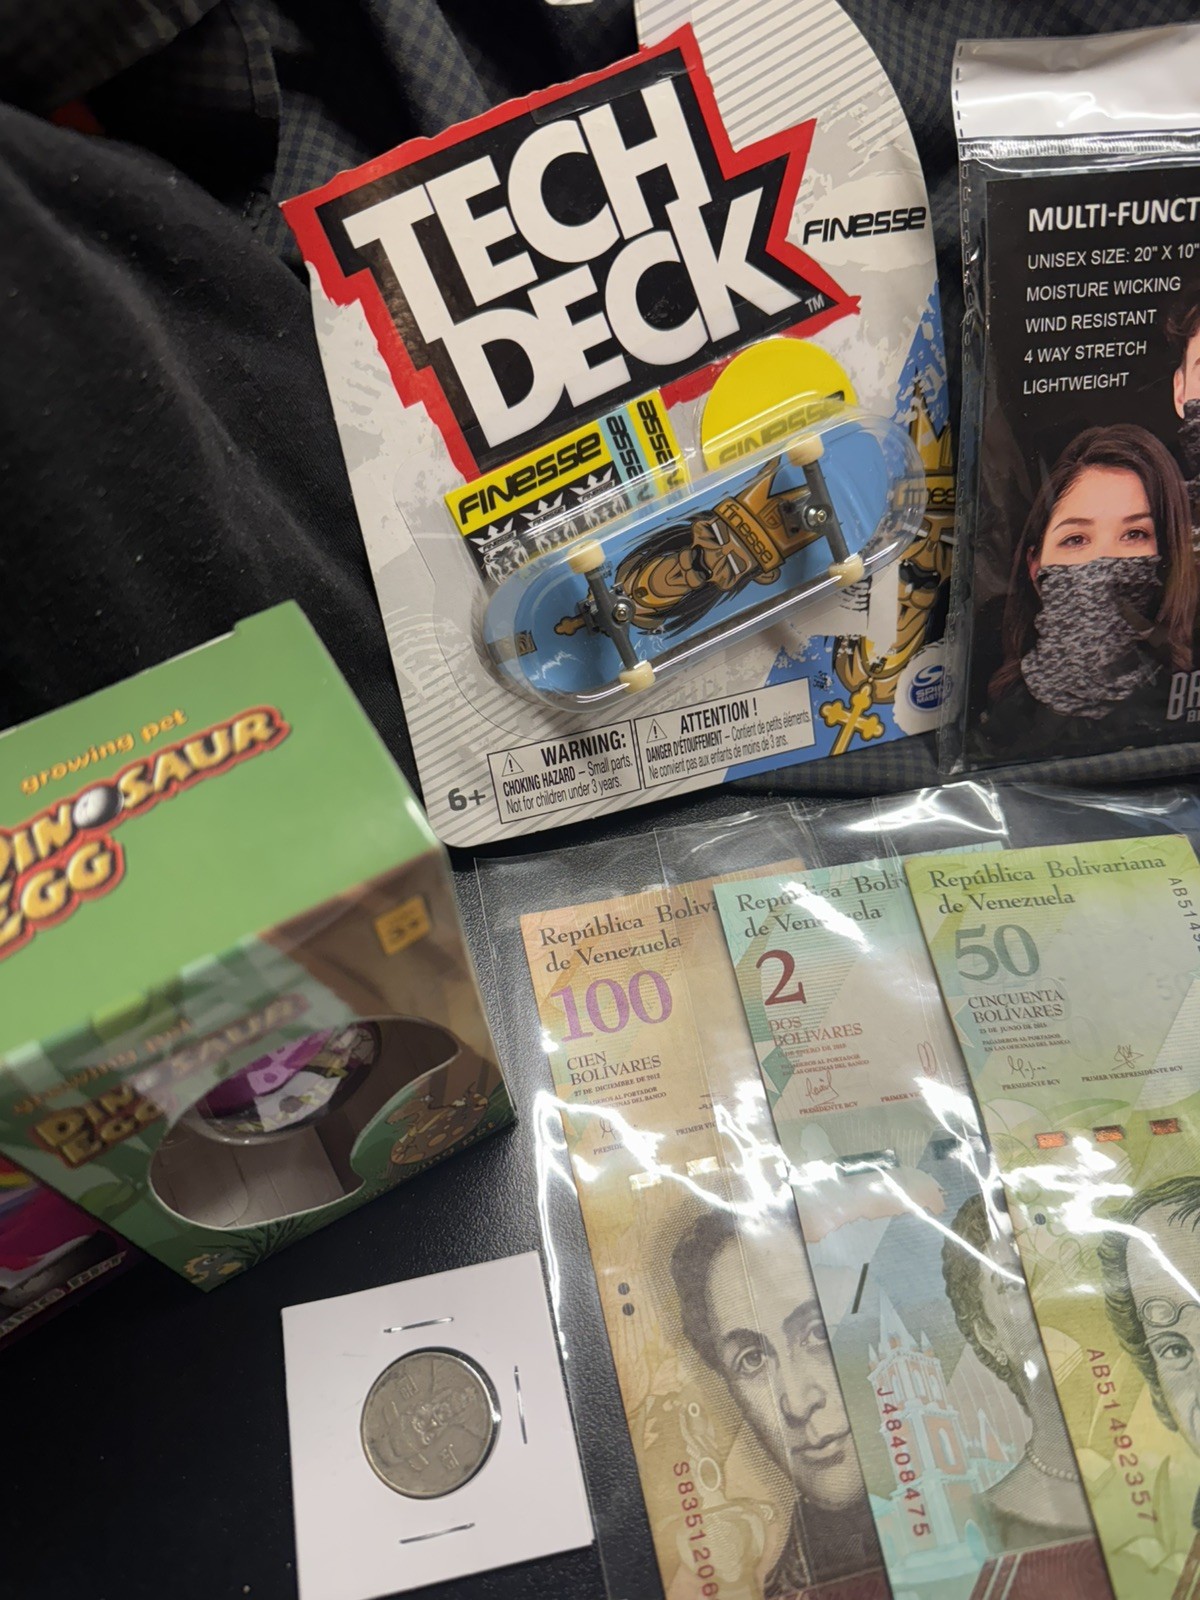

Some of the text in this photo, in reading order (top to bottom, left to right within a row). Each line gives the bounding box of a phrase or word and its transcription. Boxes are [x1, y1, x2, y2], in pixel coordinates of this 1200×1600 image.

[342, 75, 712, 343] TECH
[1027, 251, 1087, 270] UNISEX
[1091, 248, 1130, 266] SIZE:
[1134, 246, 1158, 263] 20"
[1161, 245, 1172, 260] X
[1026, 276, 1181, 302] MOISTURE WICKING
[441, 187, 802, 448] DECK
[1025, 309, 1157, 333] WIND RESISTANT
[1024, 340, 1147, 364] 4 WAY STRETCH
[1023, 372, 1129, 395] LIGHTWEIGHT
[680, 701, 749, 735] ATTENTION
[20, 709, 188, 796] growing pet
[540, 730, 627, 767] WARNING:
[646, 741, 672, 763] DANGER
[732, 721, 757, 741] Contient
[757, 720, 766, 735] de
[766, 715, 783, 734] petits
[648, 766, 659, 780] Ne
[659, 758, 686, 778] convient
[686, 757, 698, 774] pas
[698, 755, 710, 767] aux
[710, 747, 733, 764] enfants
[733, 745, 742, 759] de
[742, 740, 761, 756] moins
[761, 737, 770, 751] de
[775, 734, 789, 747] ans.
[502, 774, 541, 797] CHOKING
[541, 765, 576, 788] HAZARD
[587, 757, 610, 777] Small
[611, 754, 633, 776] parts.
[447, 787, 486, 812] 6+
[506, 776, 622, 815] Not for children under 3 years.
[928, 855, 1166, 891] República Bolivariana
[938, 884, 1075, 914] de Venezuela
[539, 914, 644, 946] República
[745, 917, 769, 938] de
[546, 929, 682, 973] de Venezuela
[955, 924, 1040, 981] 50
[756, 950, 807, 1006] 2
[550, 970, 673, 1043] 100
[768, 1016, 803, 1032] DOS
[566, 1051, 607, 1072] CIEN
[1086, 1348, 1158, 1524] AB51492357
[876, 1387, 931, 1537] J48408475
